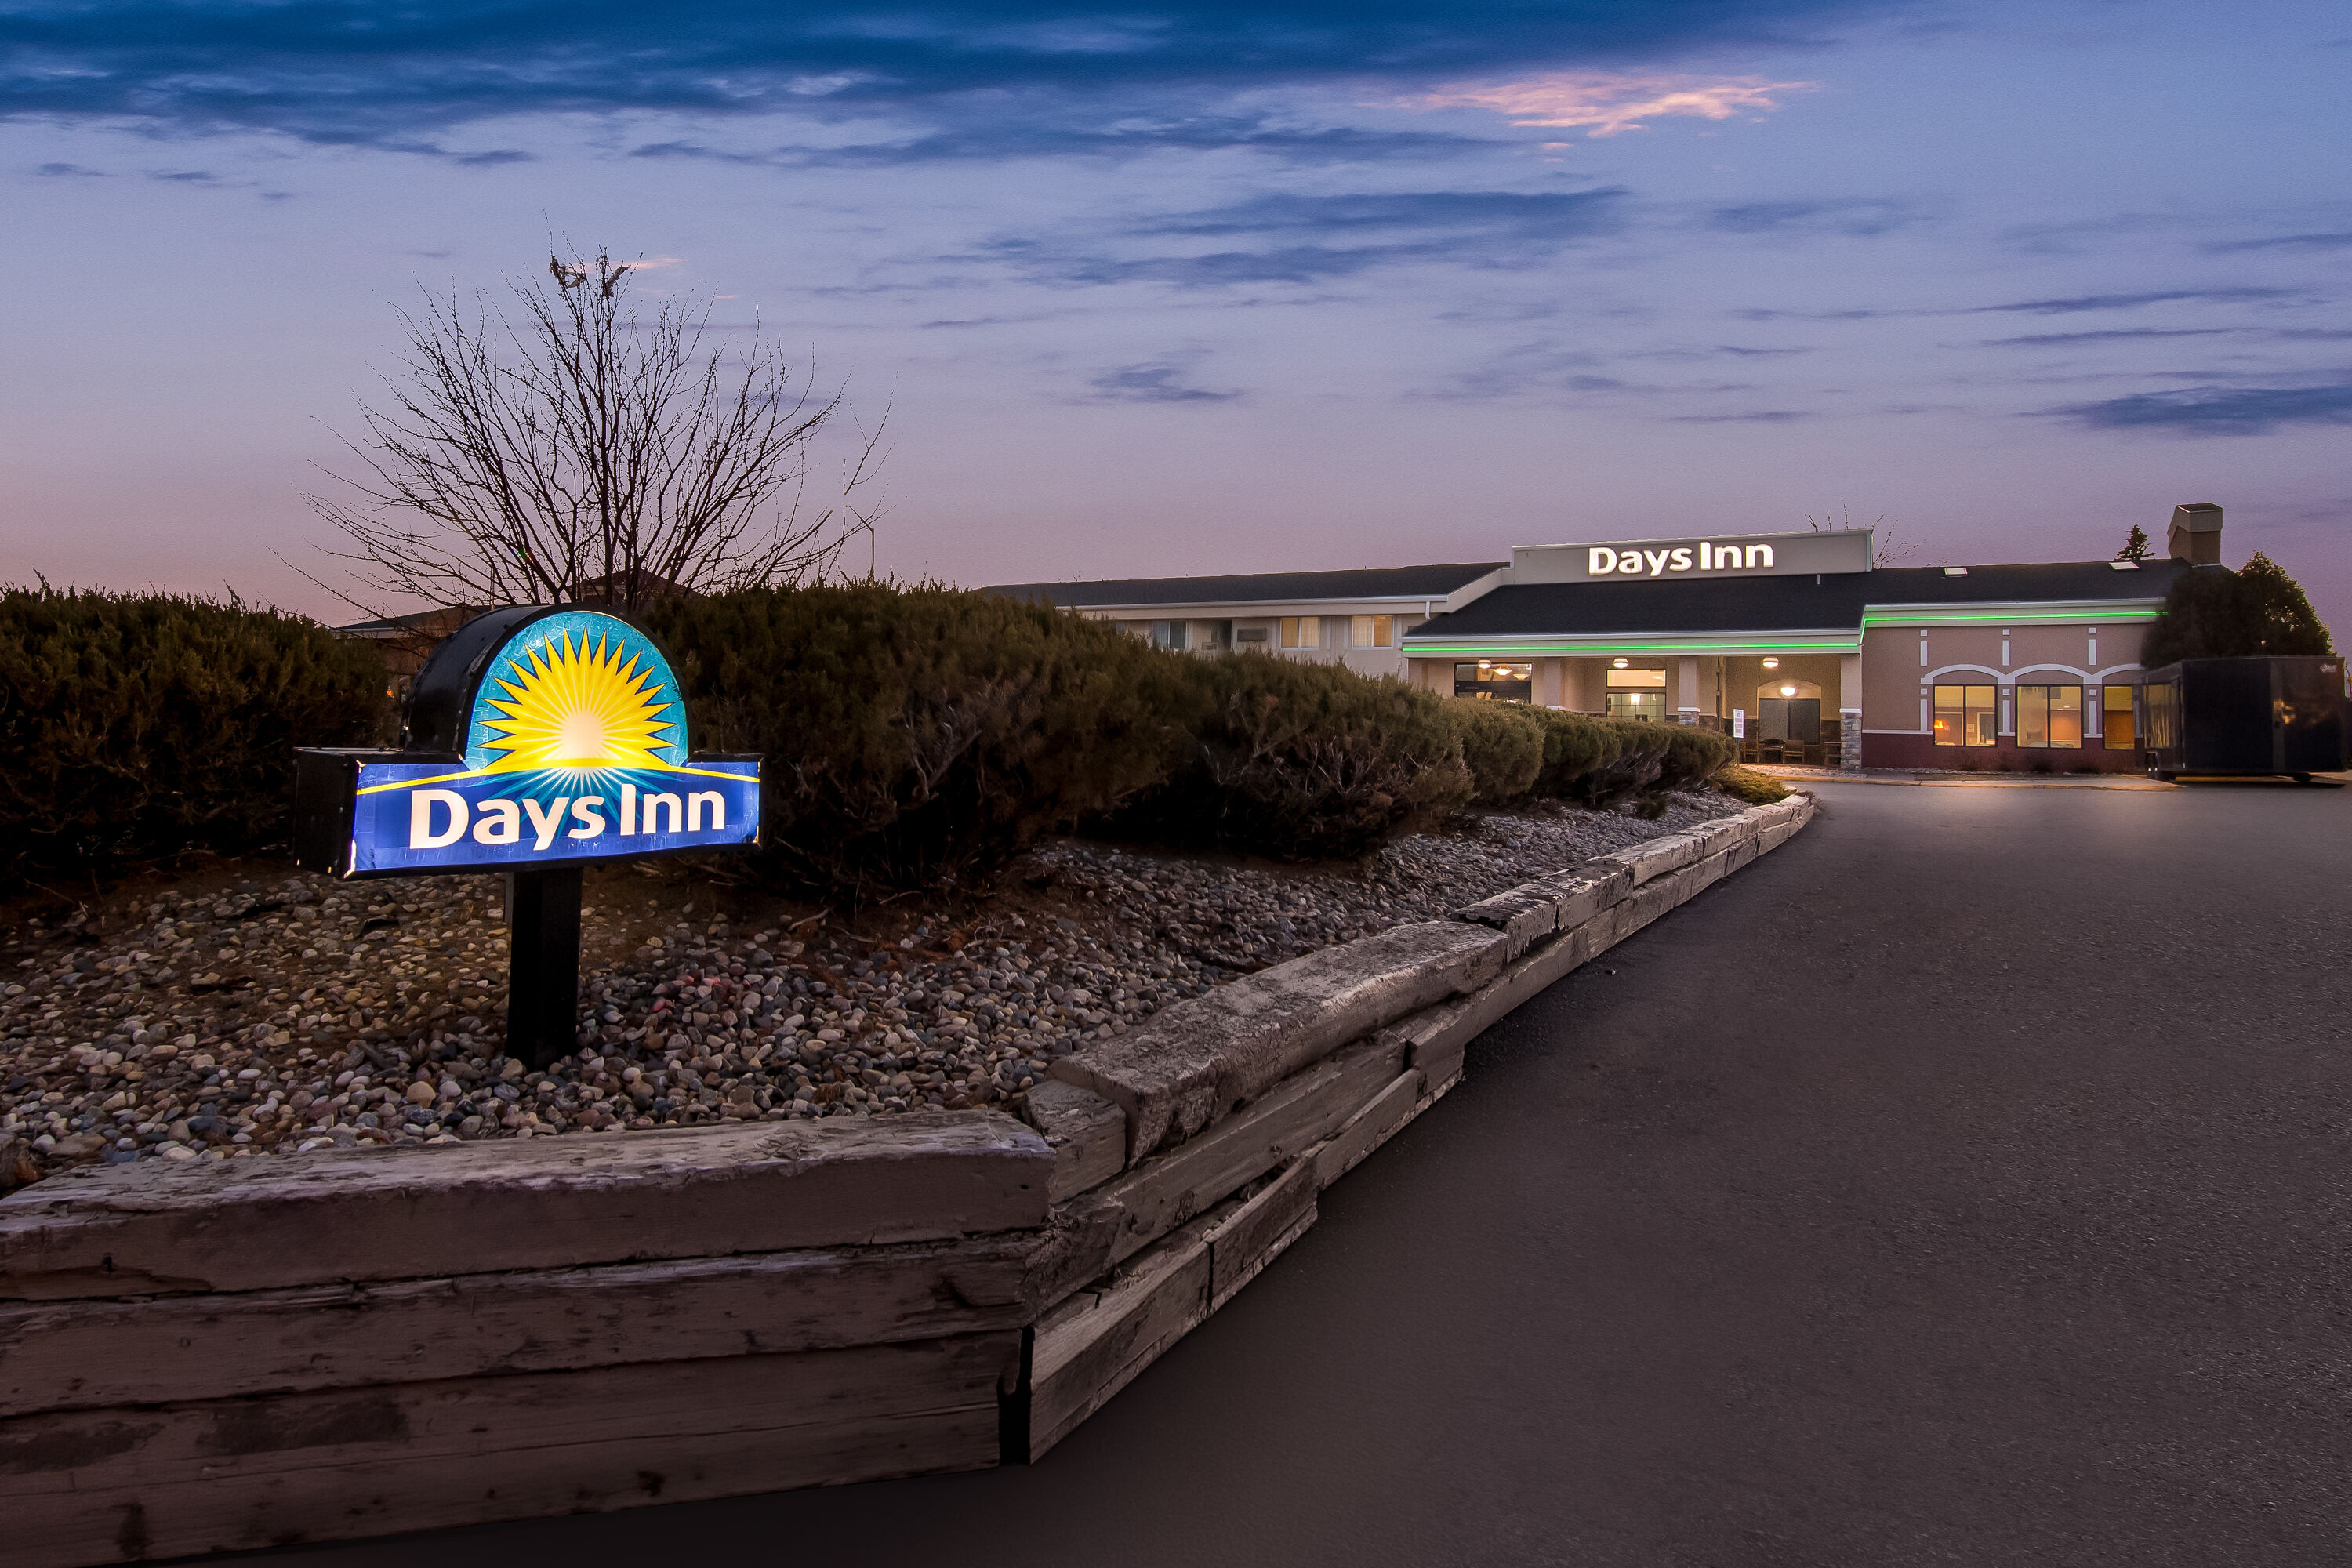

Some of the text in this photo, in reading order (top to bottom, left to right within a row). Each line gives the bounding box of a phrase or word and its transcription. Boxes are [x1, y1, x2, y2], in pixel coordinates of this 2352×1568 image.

[1588, 542, 1773, 575] Days Inn
[409, 783, 725, 851] Days Inn
